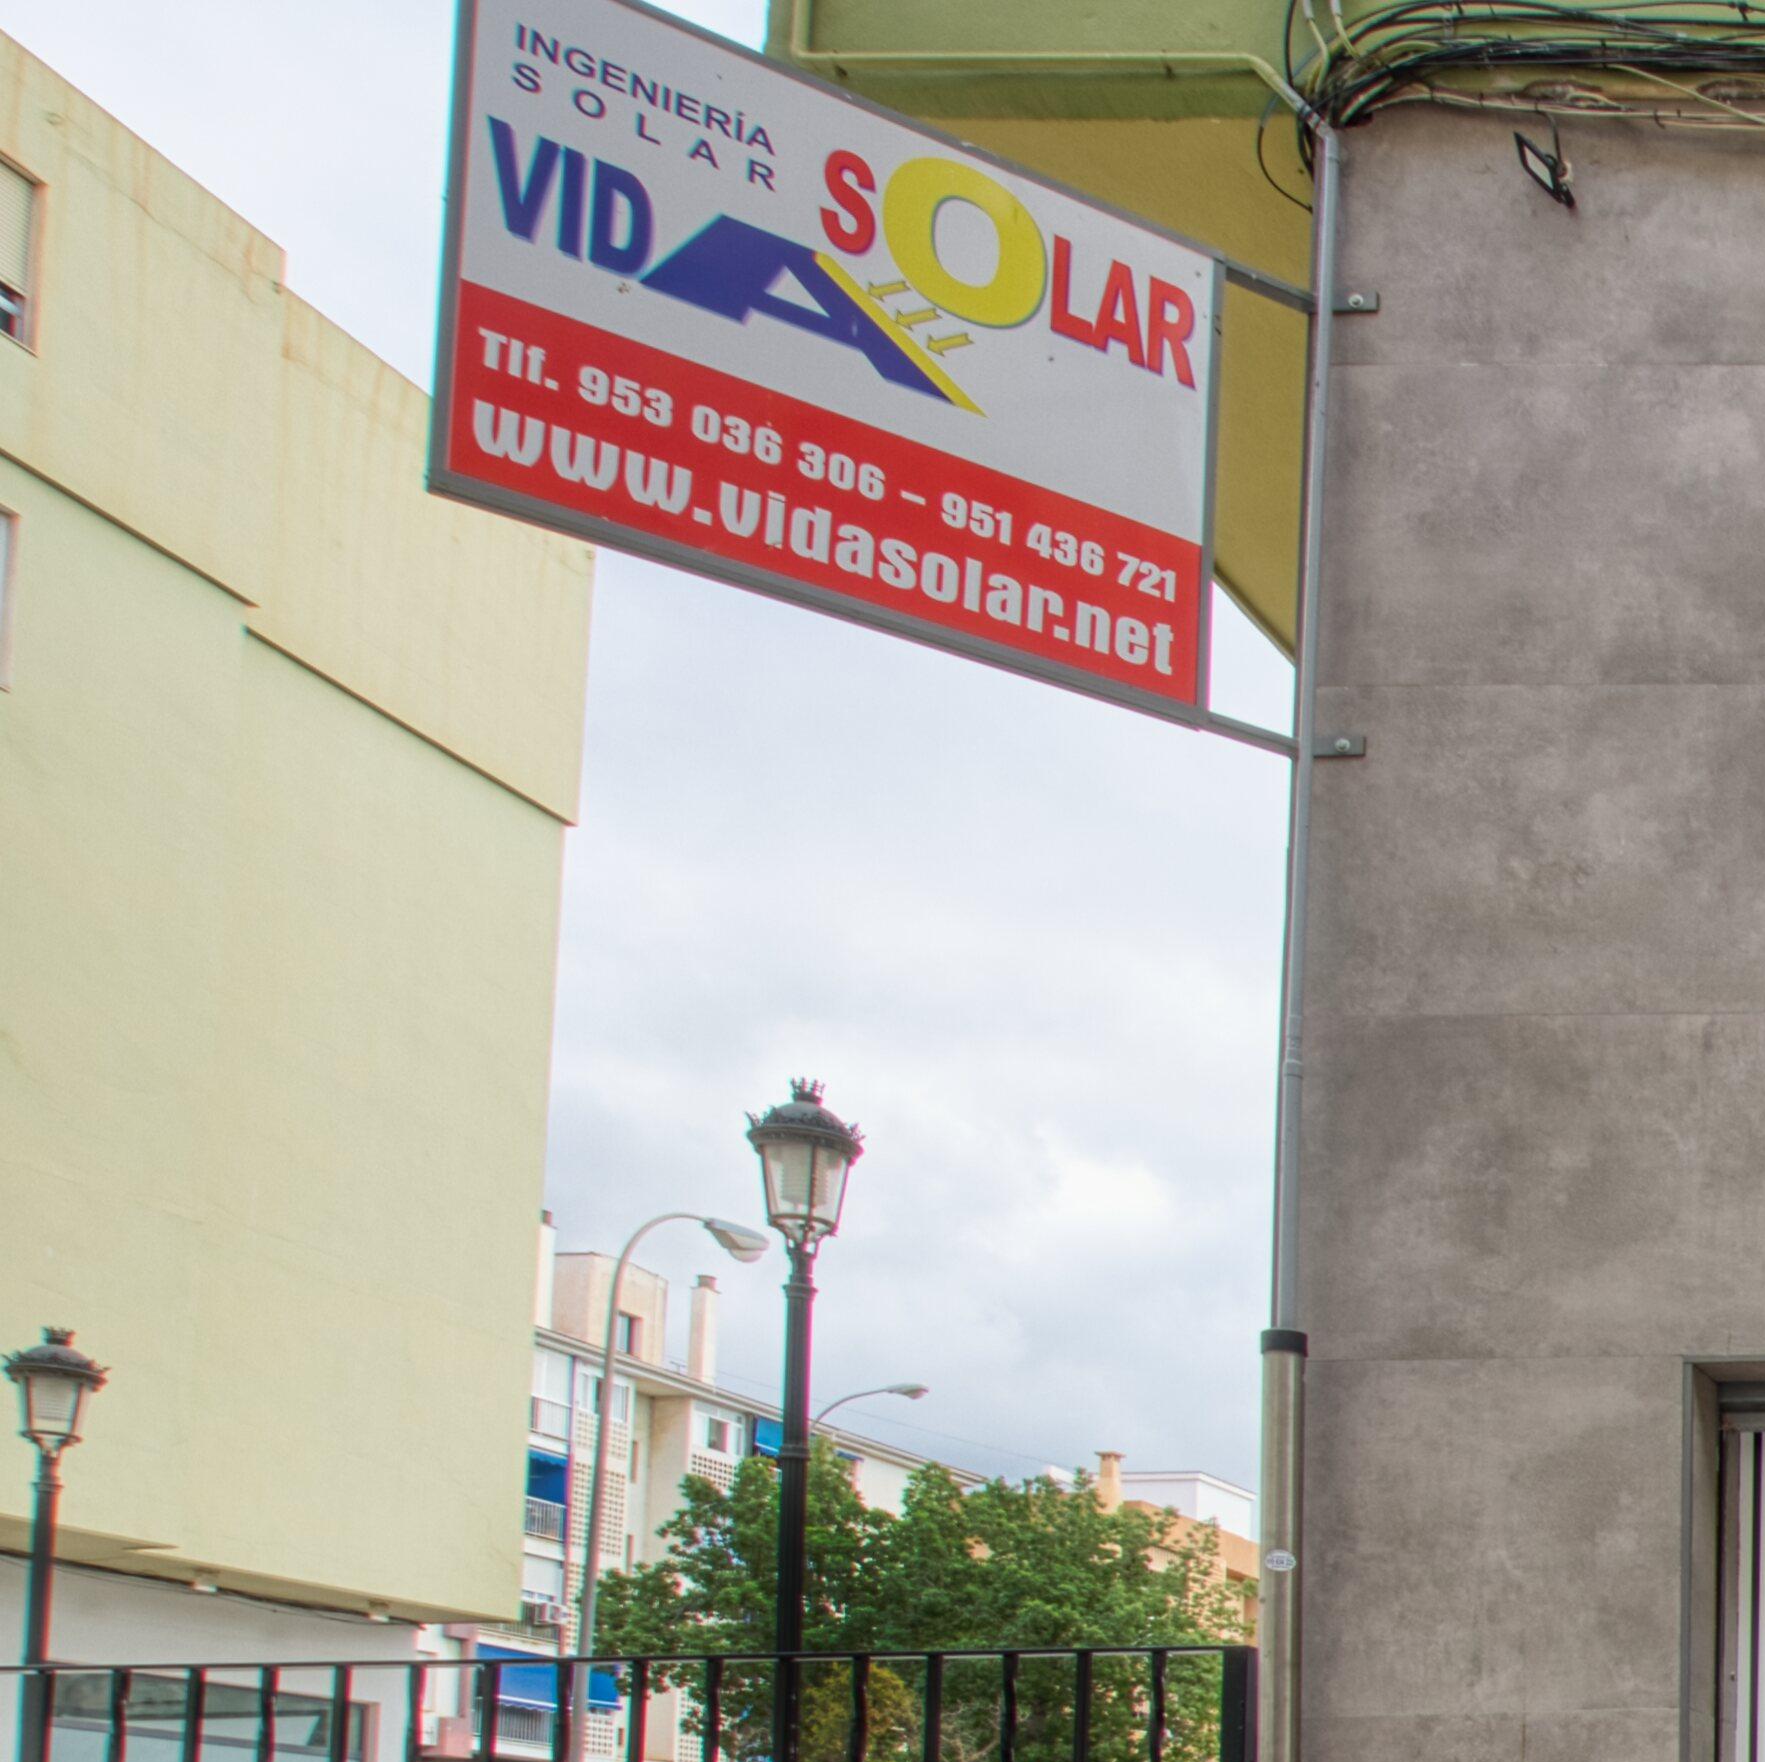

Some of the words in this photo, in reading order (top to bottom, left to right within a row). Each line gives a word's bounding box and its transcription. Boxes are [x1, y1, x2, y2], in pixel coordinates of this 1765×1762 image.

[513, 22, 776, 156] INGENIERÍA
[487, 114, 956, 406] VIDA
[819, 148, 1197, 391] SOLAR
[472, 398, 1174, 676] www.vidasolar.net
[478, 326, 559, 391] Tlf.
[577, 365, 673, 428] 953
[691, 404, 783, 465] 036
[797, 441, 886, 500] 306
[940, 492, 1013, 546] 951
[1026, 523, 1105, 577] 436
[1116, 551, 1177, 602] 721
